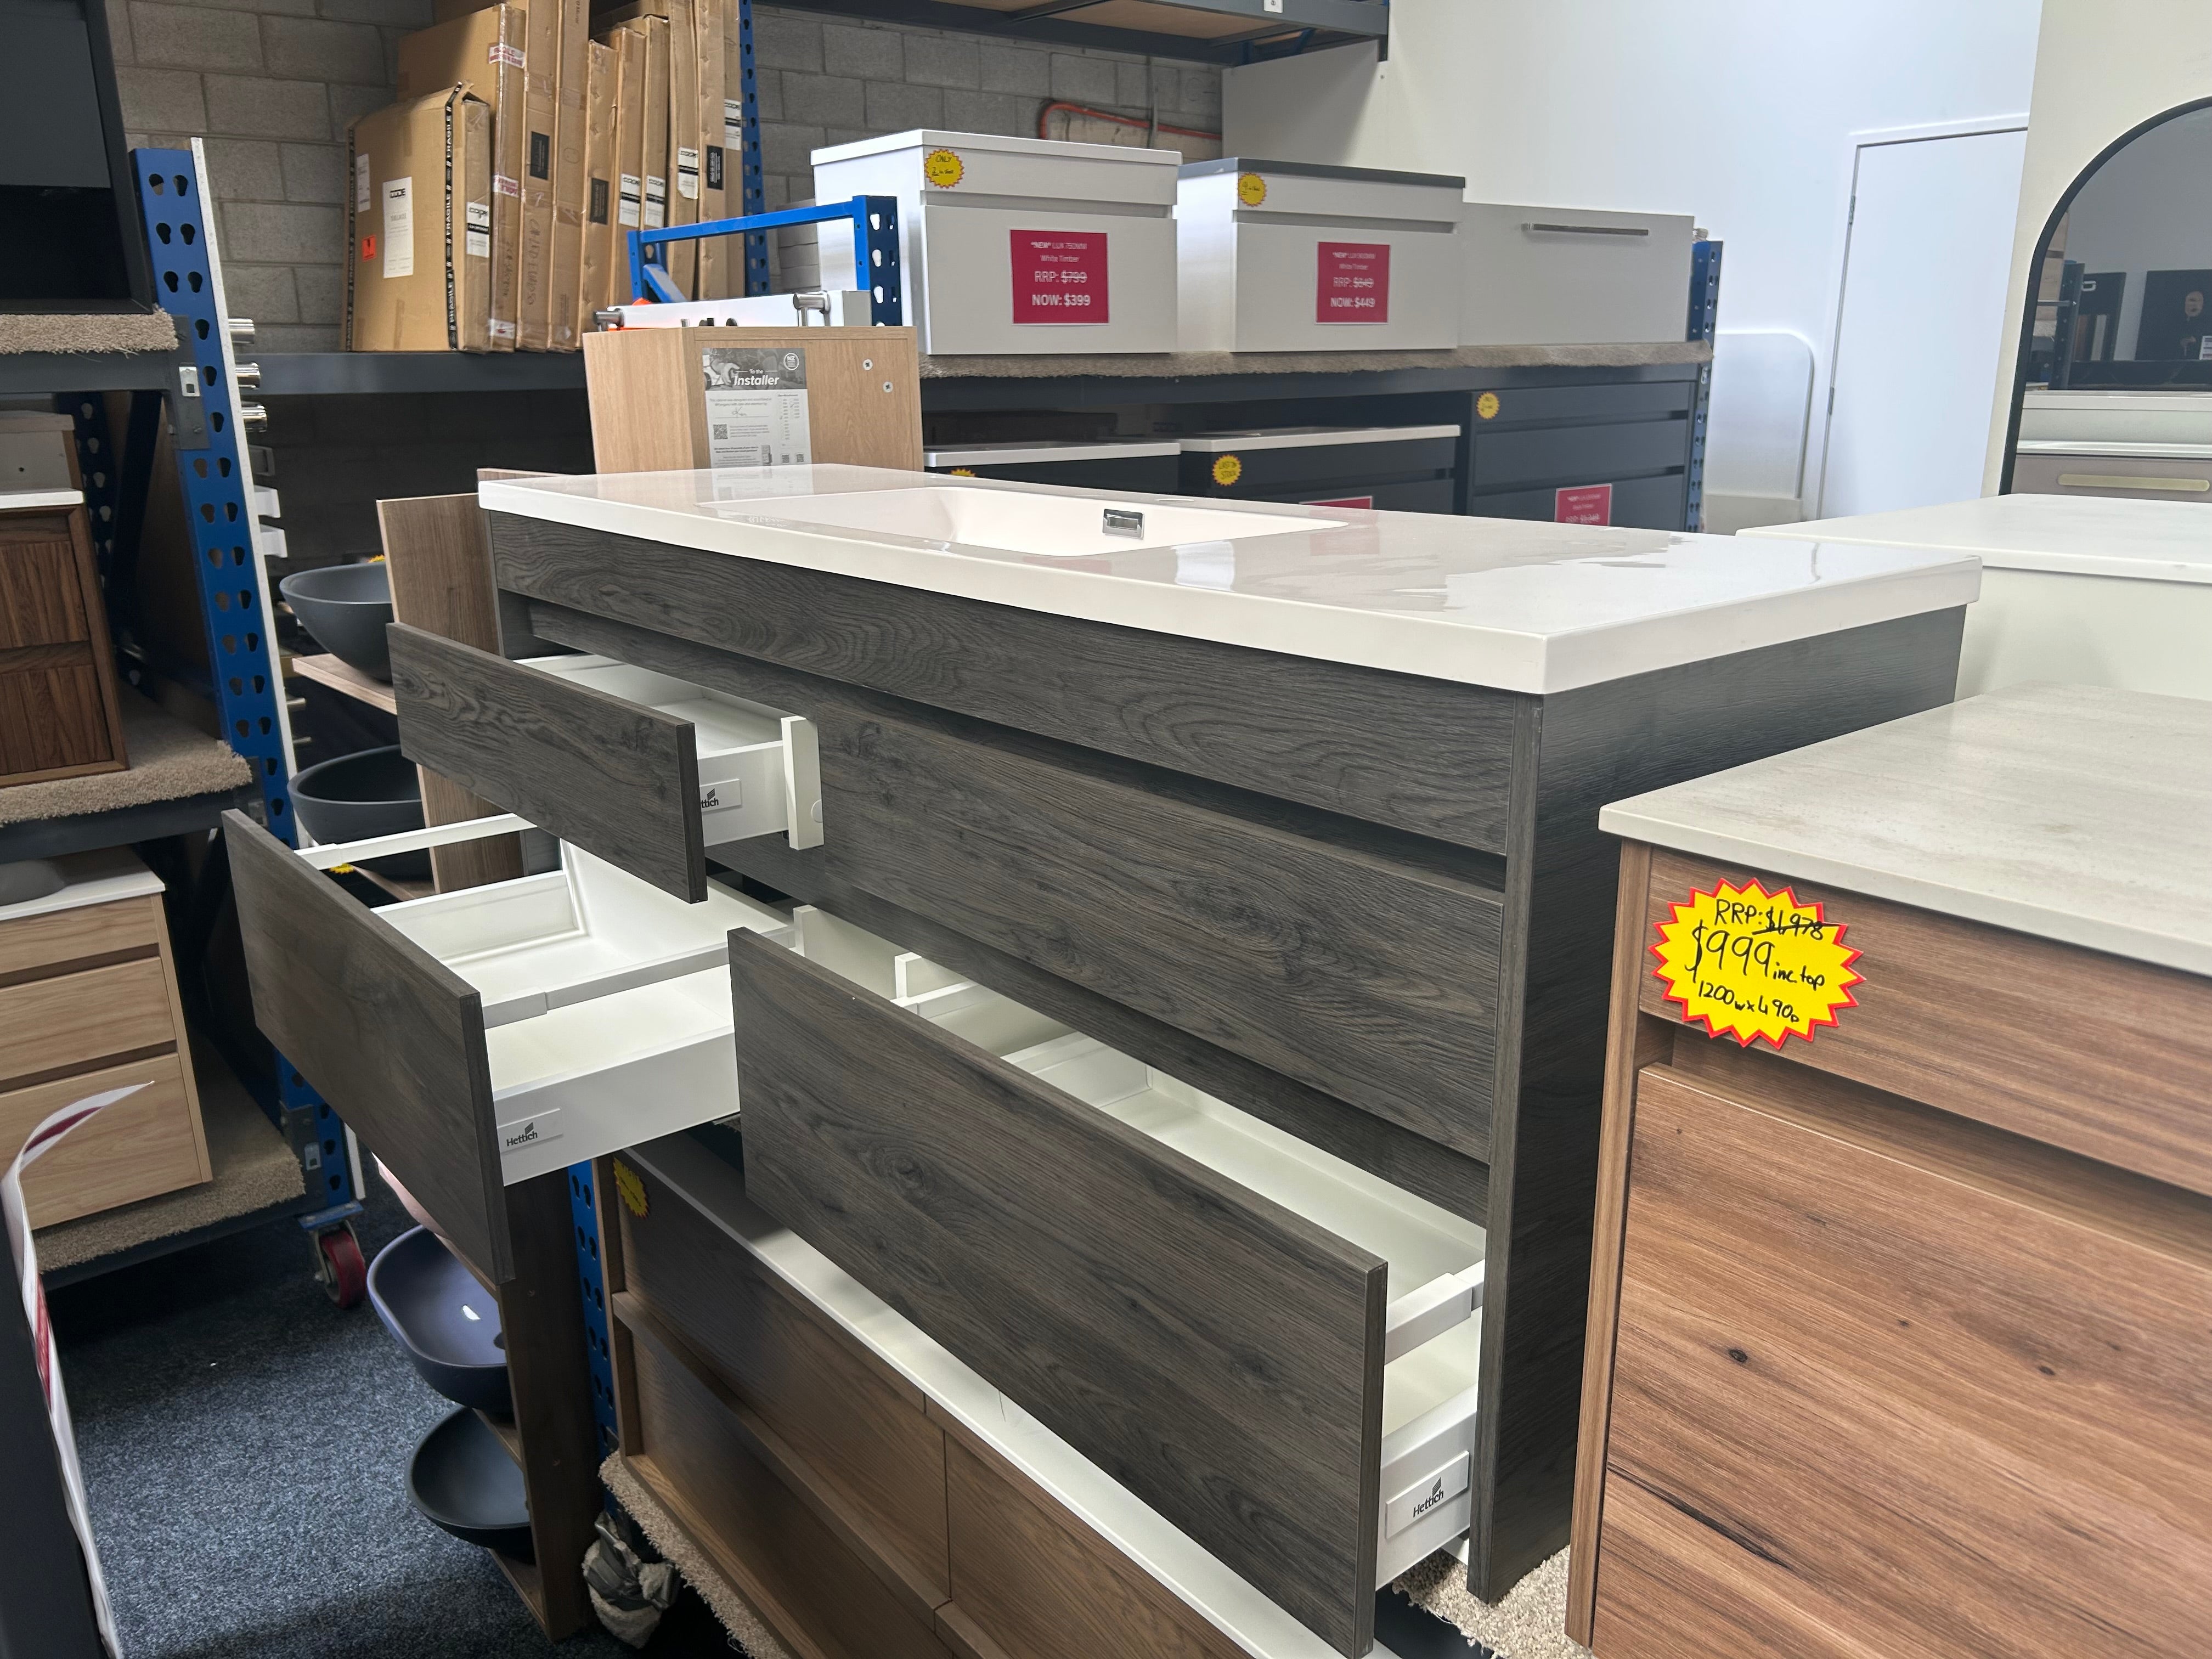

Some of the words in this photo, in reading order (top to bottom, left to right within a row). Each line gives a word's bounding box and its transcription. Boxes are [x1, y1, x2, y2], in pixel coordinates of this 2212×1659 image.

[390, 188, 407, 199] CODE
[1034, 271, 1059, 283] RRP:
[1061, 270, 1088, 284] $799
[1032, 294, 1062, 306] NOW:
[1063, 293, 1091, 307] $399
[1330, 297, 1353, 308] NOW:
[733, 375, 780, 386] Installer
[701, 797, 719, 809] ttich
[1714, 899, 1763, 926] RRP:
[1684, 919, 1775, 983] $999
[1773, 961, 1797, 983] inc
[1801, 965, 1825, 991] top
[506, 1130, 538, 1147] Hettich
[1413, 1488, 1444, 1518] Hettich
